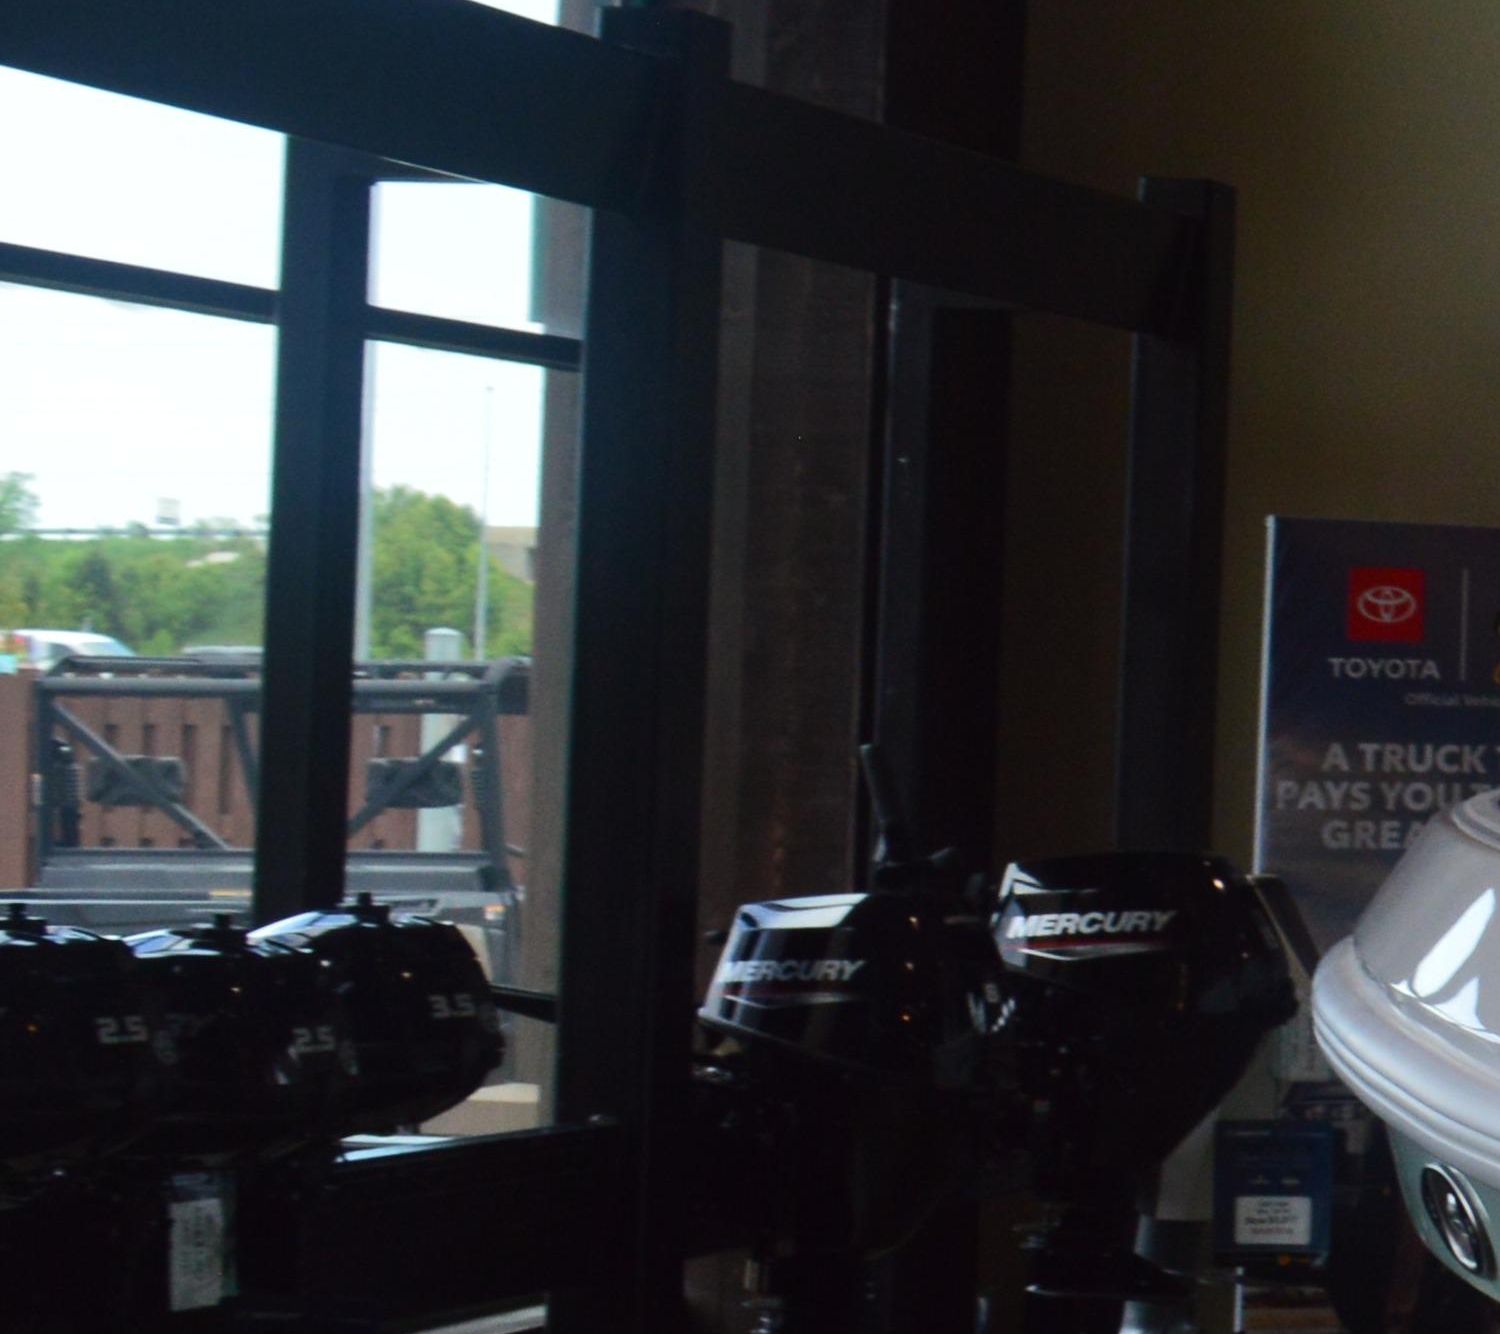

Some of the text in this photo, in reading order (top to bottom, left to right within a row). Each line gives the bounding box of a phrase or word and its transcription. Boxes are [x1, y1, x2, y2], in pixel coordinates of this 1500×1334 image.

[1327, 656, 1442, 681] TOYOTA
[1321, 742, 1349, 772] A
[1357, 742, 1487, 774] TRUCK
[1275, 779, 1372, 811] PAYS
[1380, 781, 1462, 812] YOU
[1007, 909, 1178, 938] MERCURY
[714, 958, 867, 985] MERCURY
